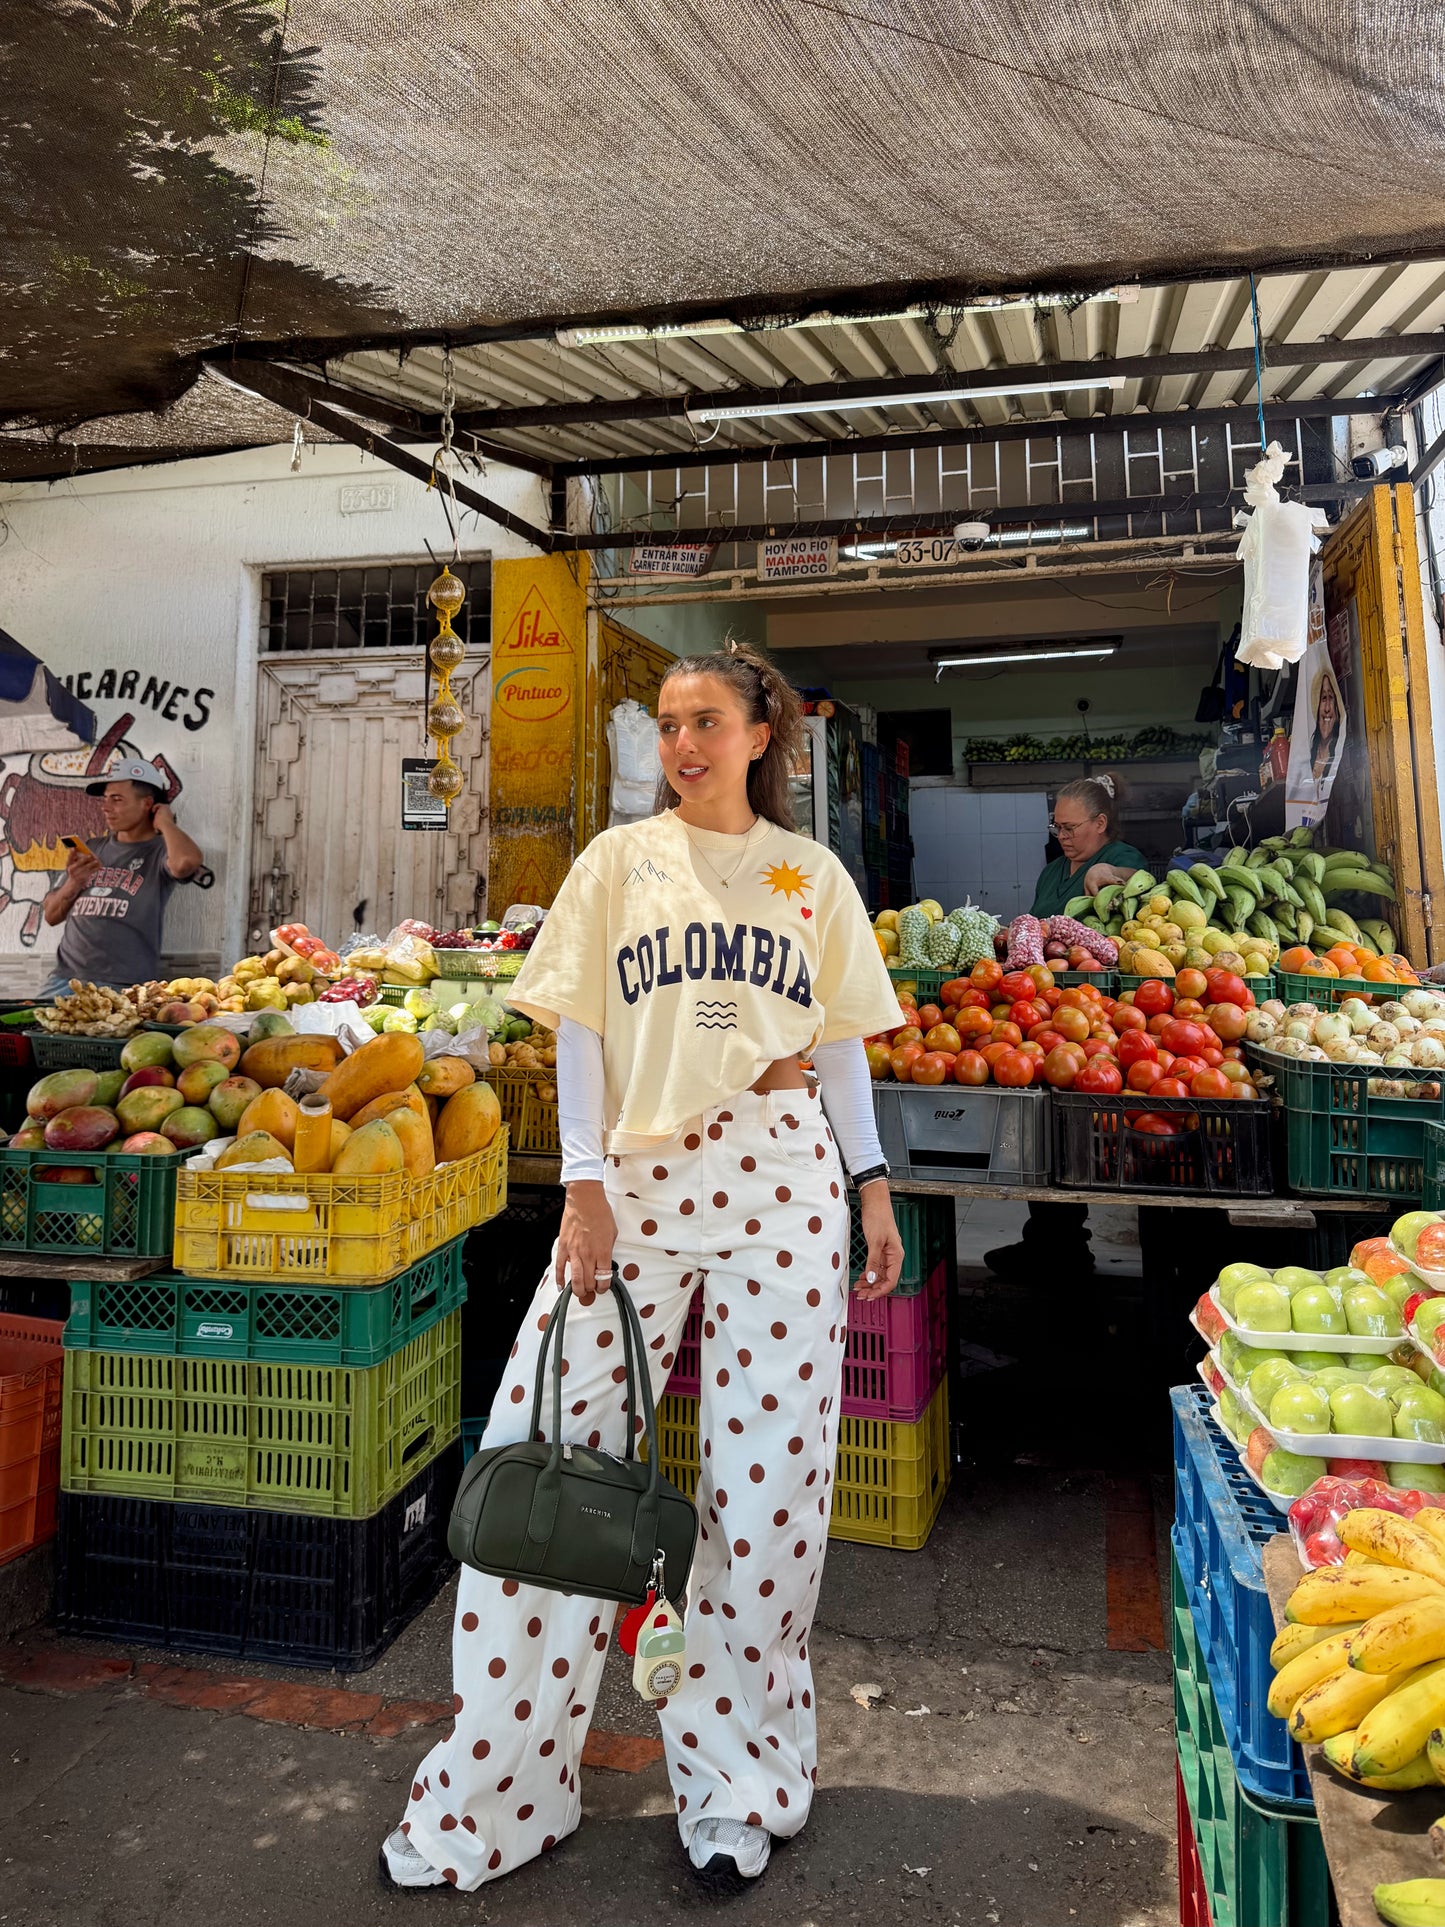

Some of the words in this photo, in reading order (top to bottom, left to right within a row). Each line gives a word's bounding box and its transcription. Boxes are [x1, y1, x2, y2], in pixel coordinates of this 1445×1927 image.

[765, 543, 787, 555] HOY
[791, 542, 806, 553] NO
[810, 540, 828, 552] FIO
[899, 539, 955, 563] 33-07
[642, 549, 677, 561] ENTRAR
[681, 551, 696, 562] SIN
[766, 553, 827, 567] MAÑANA
[633, 559, 660, 571] CARNET
[661, 561, 670, 571] DE
[766, 564, 827, 577] TAMPOCO
[508, 609, 561, 650] Sika
[503, 684, 562, 702] Pintuco
[617, 922, 813, 1008] COLOMBIA
